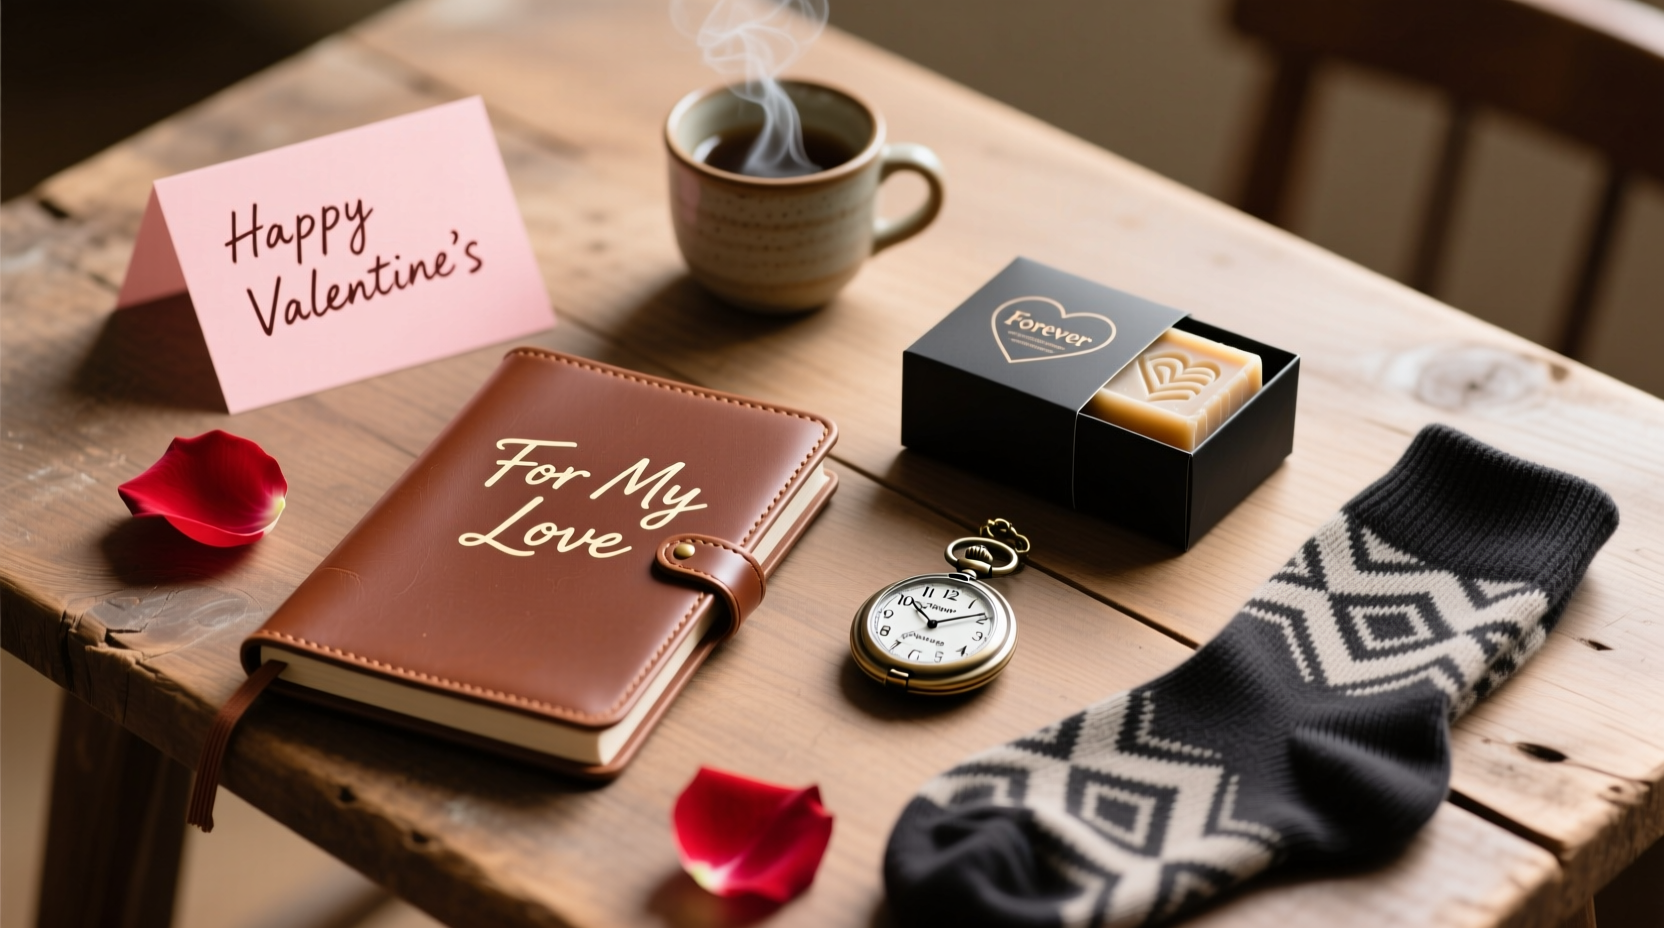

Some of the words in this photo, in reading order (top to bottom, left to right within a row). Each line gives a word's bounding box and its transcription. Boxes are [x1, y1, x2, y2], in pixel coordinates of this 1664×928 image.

[225, 199, 373, 265] Happy
[1004, 310, 1093, 346] Forever
[484, 438, 591, 490] For
[589, 457, 708, 530] My
[458, 496, 632, 558] Love
[897, 594, 914, 606] 10
[922, 586, 935, 598] 11
[943, 589, 960, 601] 12
